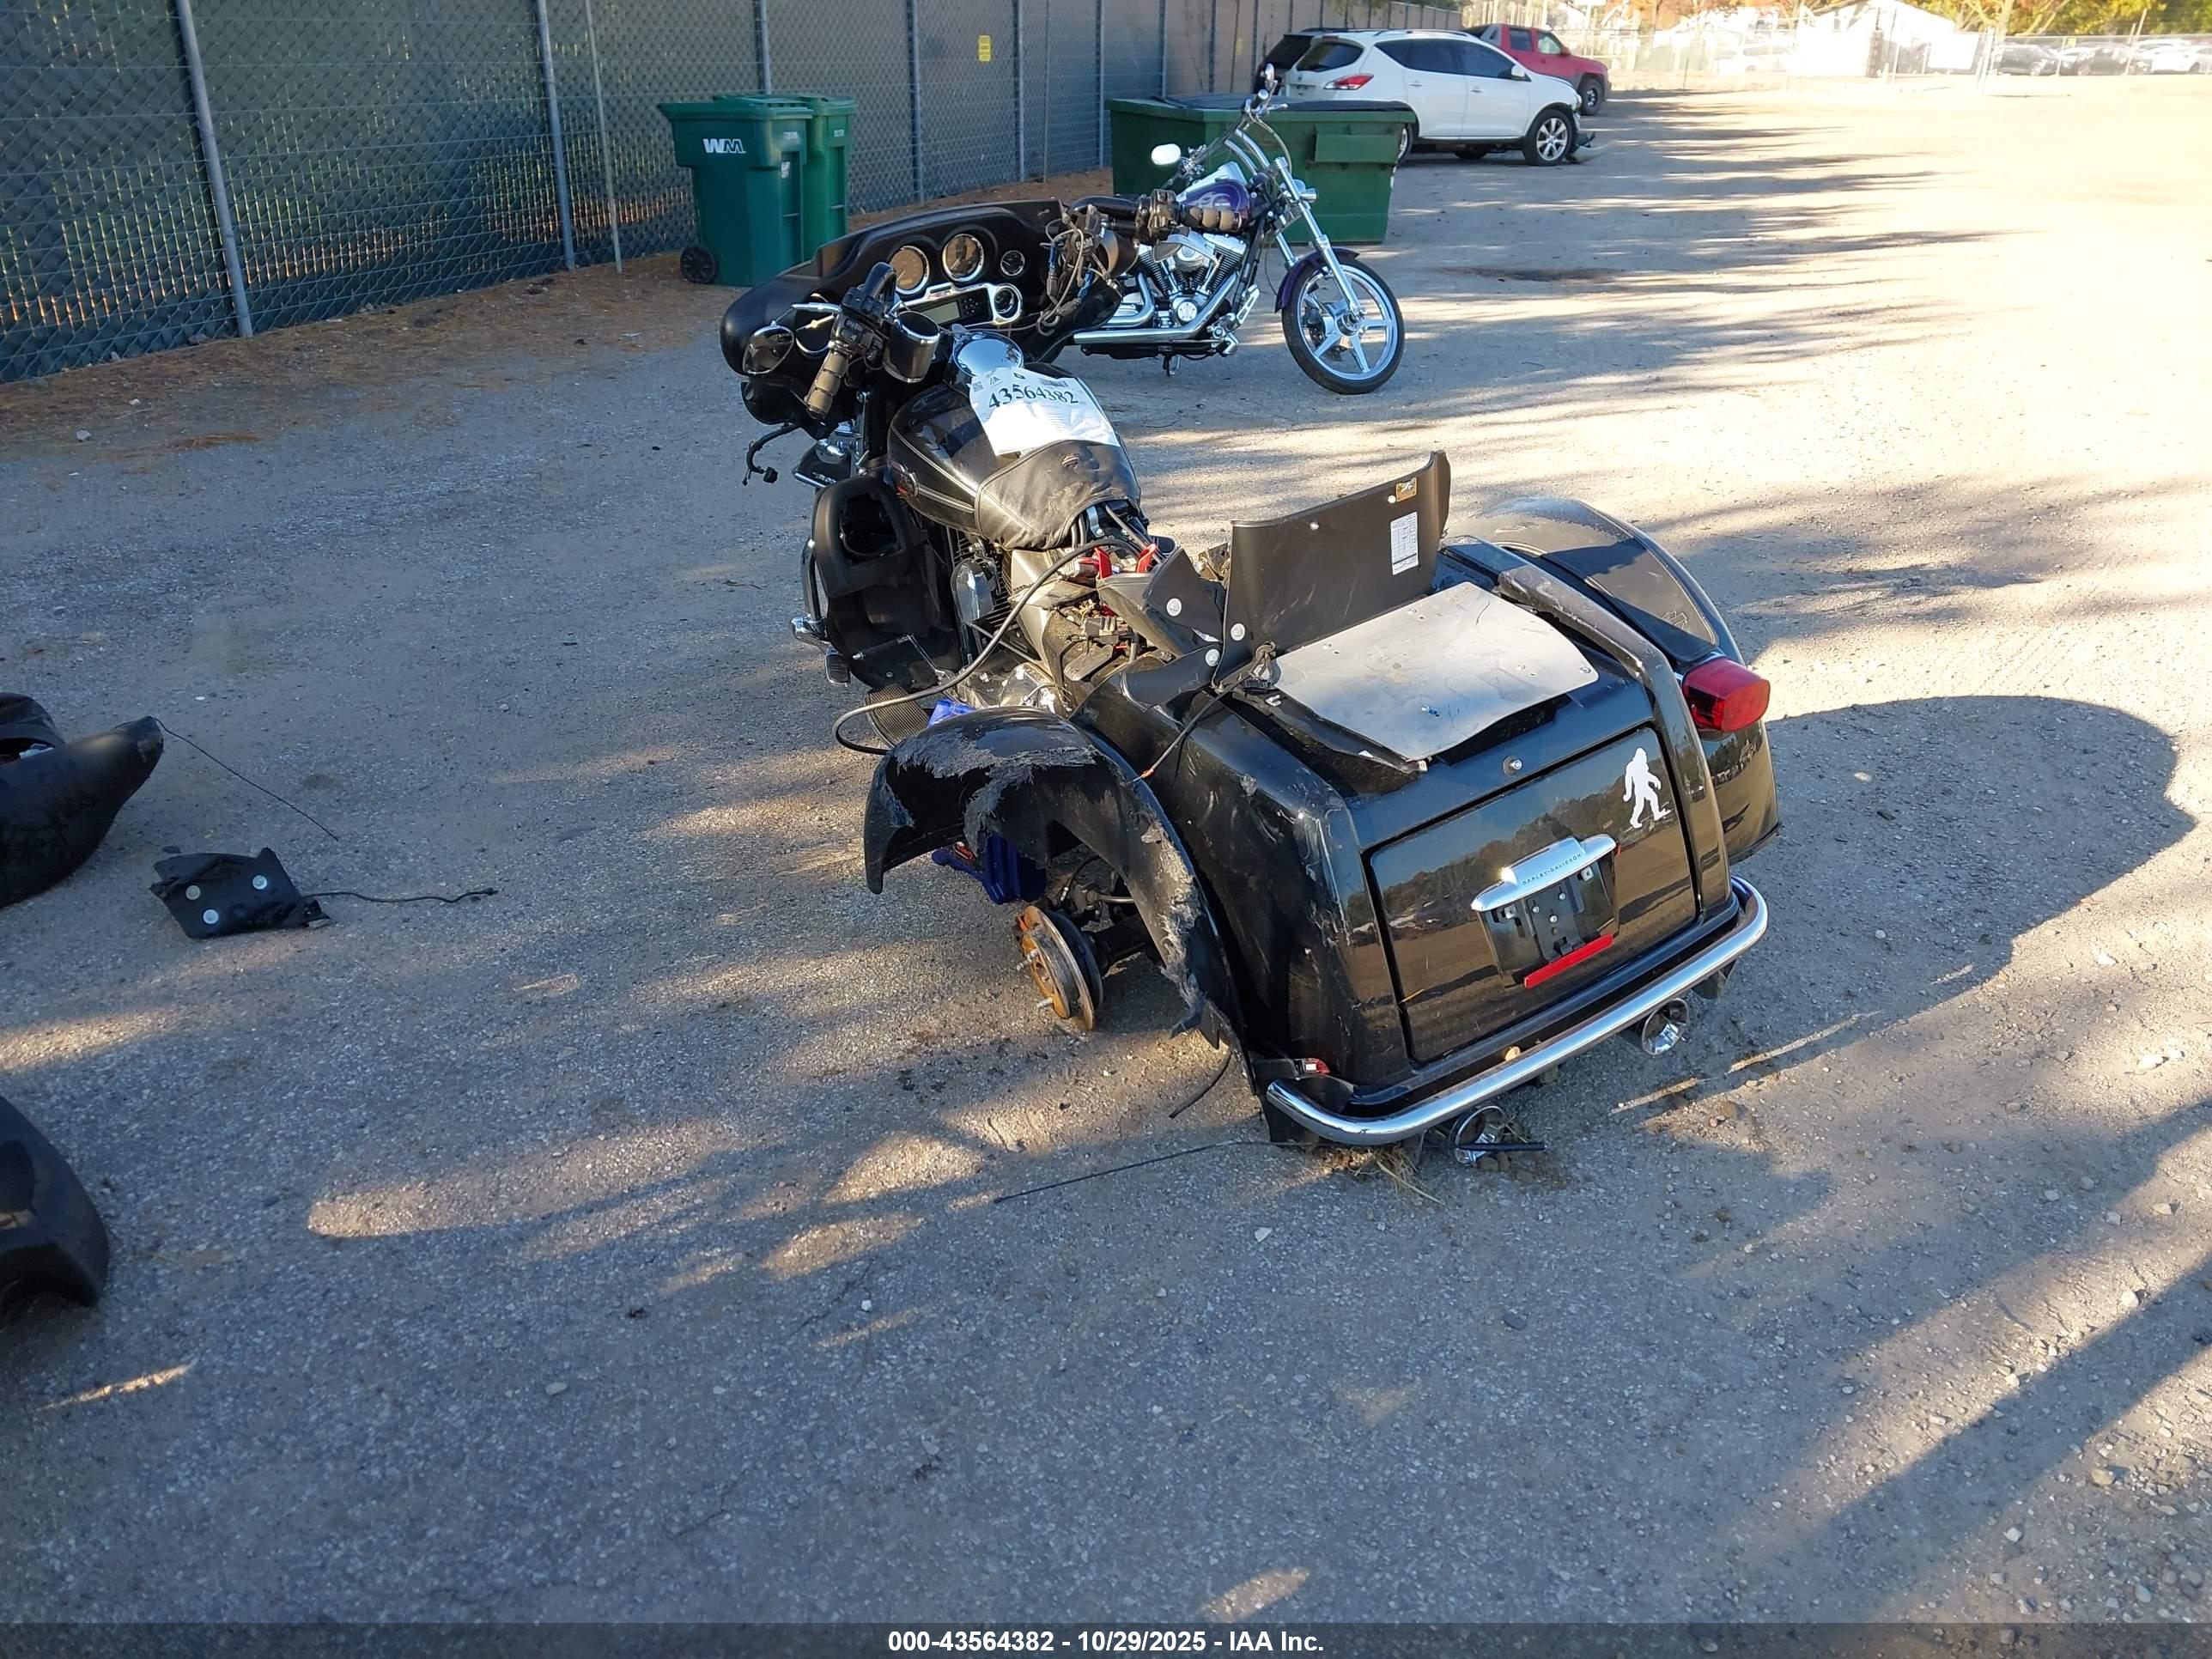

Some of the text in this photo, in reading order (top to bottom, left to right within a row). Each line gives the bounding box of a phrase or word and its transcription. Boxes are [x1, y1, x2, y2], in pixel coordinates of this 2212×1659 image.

[702, 138, 746, 154] WM
[988, 383, 1079, 409] 43564382
[1522, 854, 1582, 884] HARLEY-DAVIDSON
